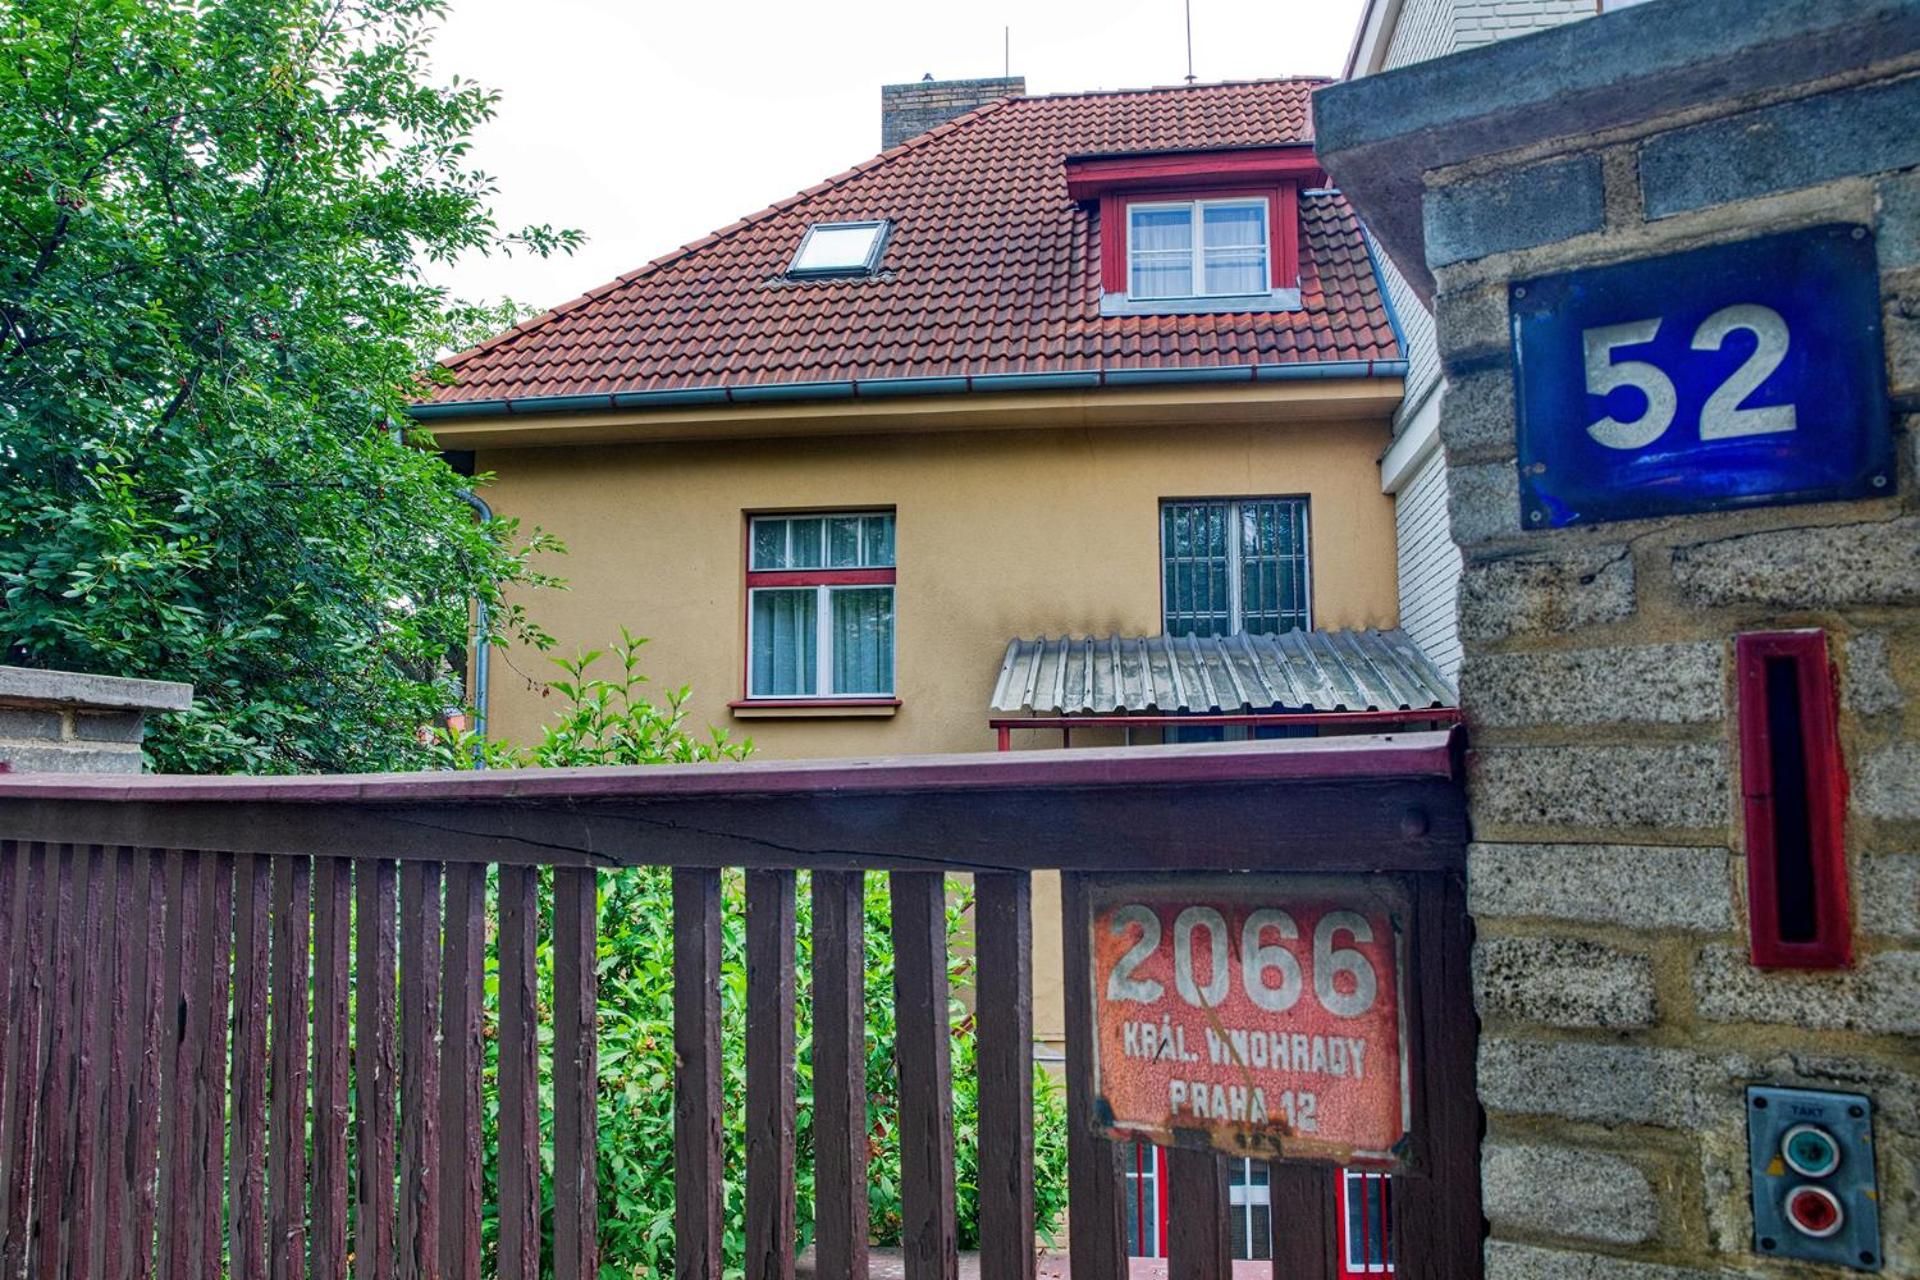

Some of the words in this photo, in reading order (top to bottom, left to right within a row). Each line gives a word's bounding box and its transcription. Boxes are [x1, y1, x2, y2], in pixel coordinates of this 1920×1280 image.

[1582, 302, 1797, 450] 52
[1106, 904, 1377, 1019] 2066
[1123, 1013, 1198, 1063] KRÁL.
[1205, 1026, 1366, 1080] VINOHRADY
[1169, 1078, 1268, 1125] PRAHA
[1279, 1090, 1318, 1133] 12
